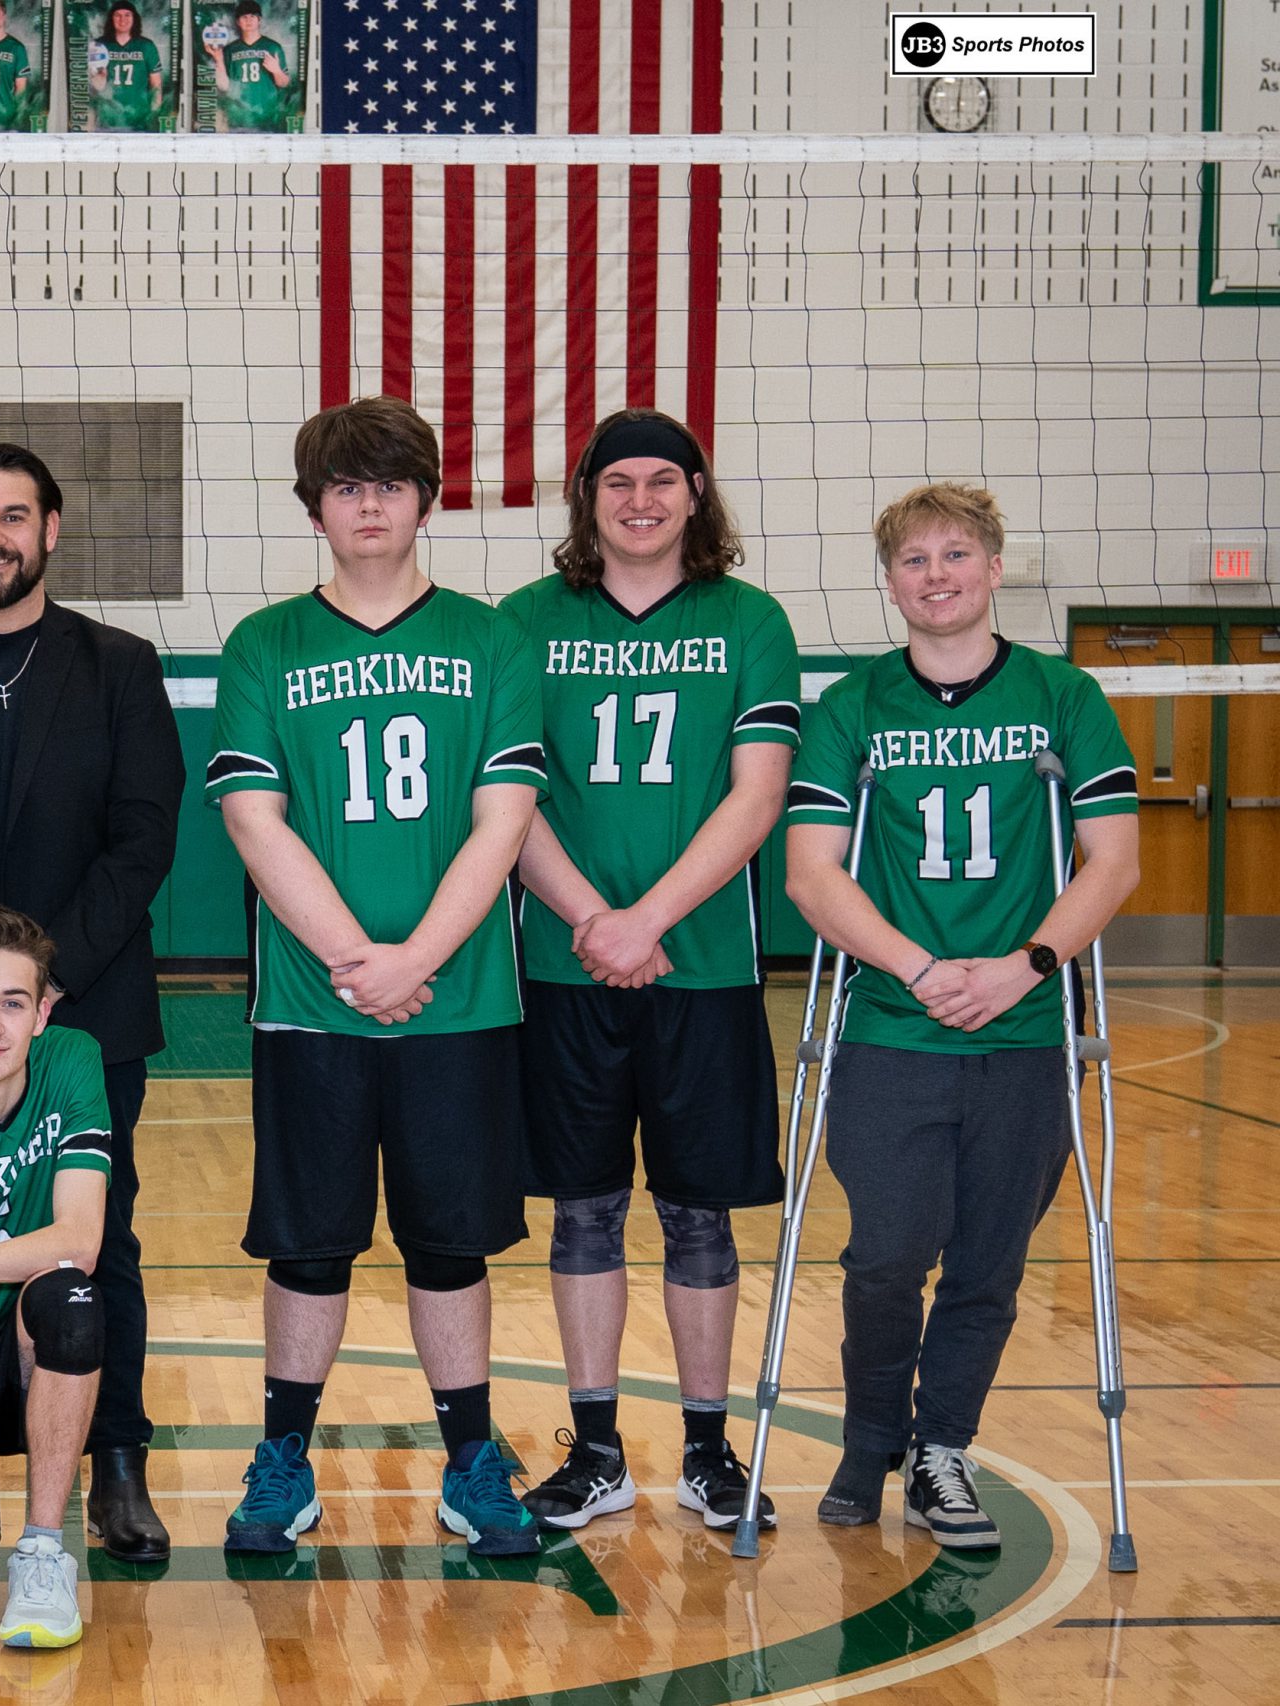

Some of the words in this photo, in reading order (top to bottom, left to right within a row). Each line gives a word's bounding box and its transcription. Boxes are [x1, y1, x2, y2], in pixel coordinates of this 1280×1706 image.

[113, 64, 134, 85] 17
[241, 62, 260, 83] 18
[1261, 57, 1280, 72] St
[1267, 223, 1280, 238] T
[1215, 549, 1254, 578] EXIT
[546, 637, 728, 676] HERKIMER
[285, 653, 473, 711] HERKIMER
[588, 689, 679, 785] 17
[867, 723, 1050, 771] HERKIMER
[339, 713, 429, 824] 18
[917, 783, 999, 881] 11
